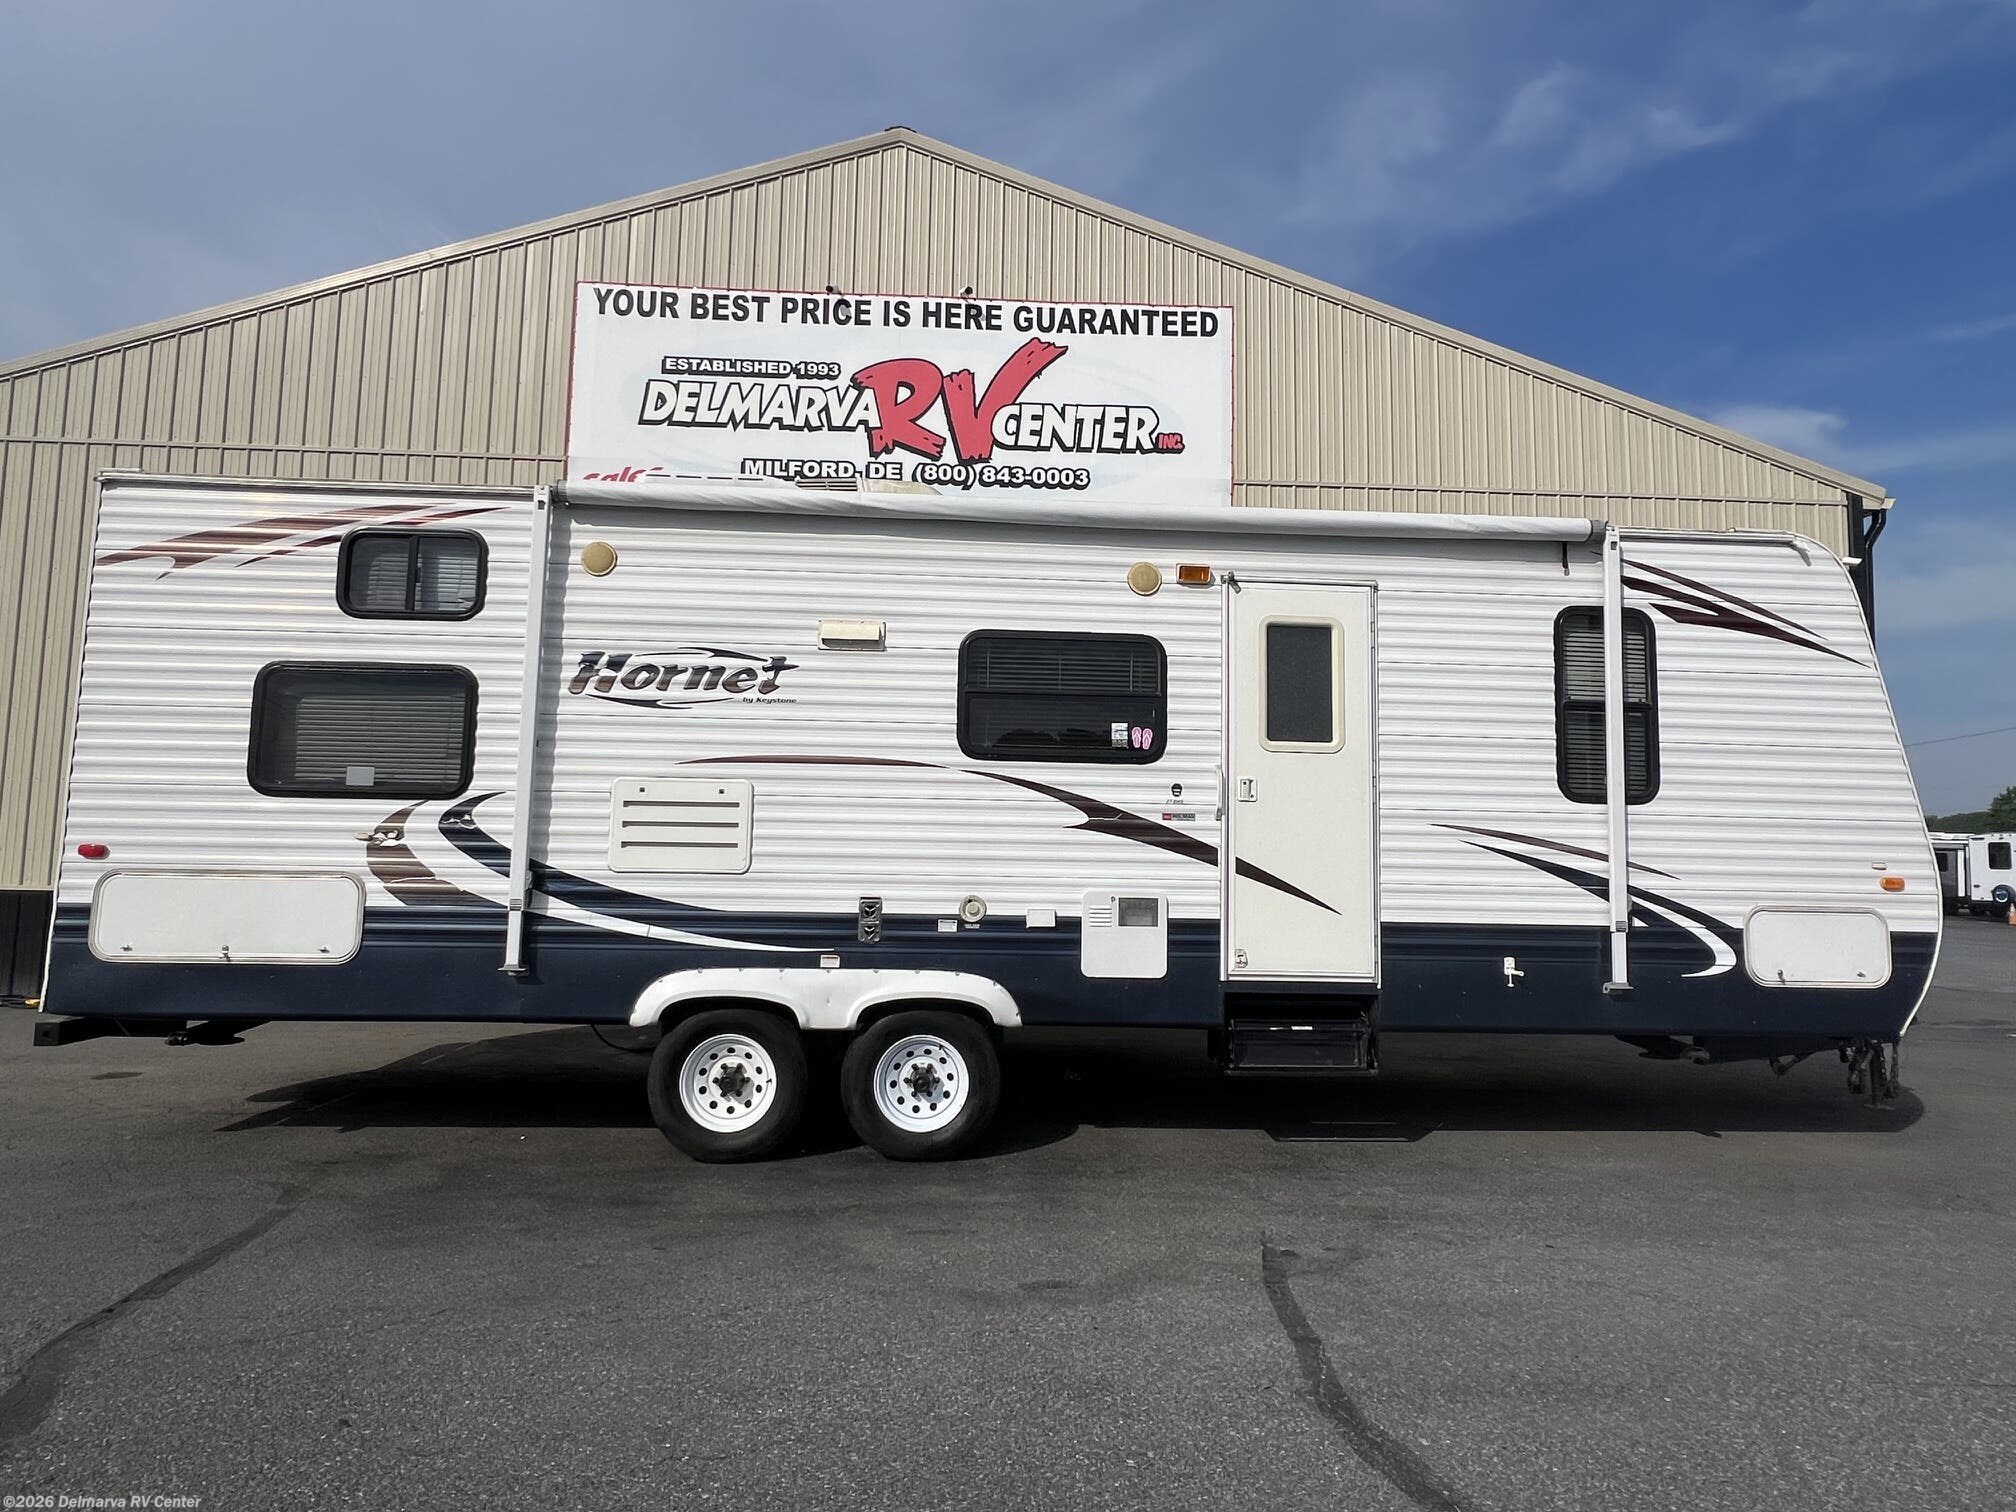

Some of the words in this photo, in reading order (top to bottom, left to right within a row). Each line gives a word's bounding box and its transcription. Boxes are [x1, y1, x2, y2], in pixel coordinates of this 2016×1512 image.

[593, 287, 679, 319] YOUR
[690, 293, 770, 322] BEST
[781, 296, 872, 326] PRICE
[883, 300, 911, 327] IS
[922, 301, 1003, 331] HERE
[1013, 305, 1219, 337] GUARANTEED
[662, 356, 791, 377] ESTABLISHED
[796, 361, 841, 379] 1993
[638, 379, 882, 432] DELMARVA
[850, 337, 1068, 464] RV
[991, 402, 1160, 453] CENTER
[866, 461, 903, 480] DE
[911, 463, 976, 490] (800)
[980, 465, 1091, 490] 843-0003
[568, 650, 800, 695] Hornet
[742, 696, 754, 704] by
[756, 696, 798, 705] Keystone
